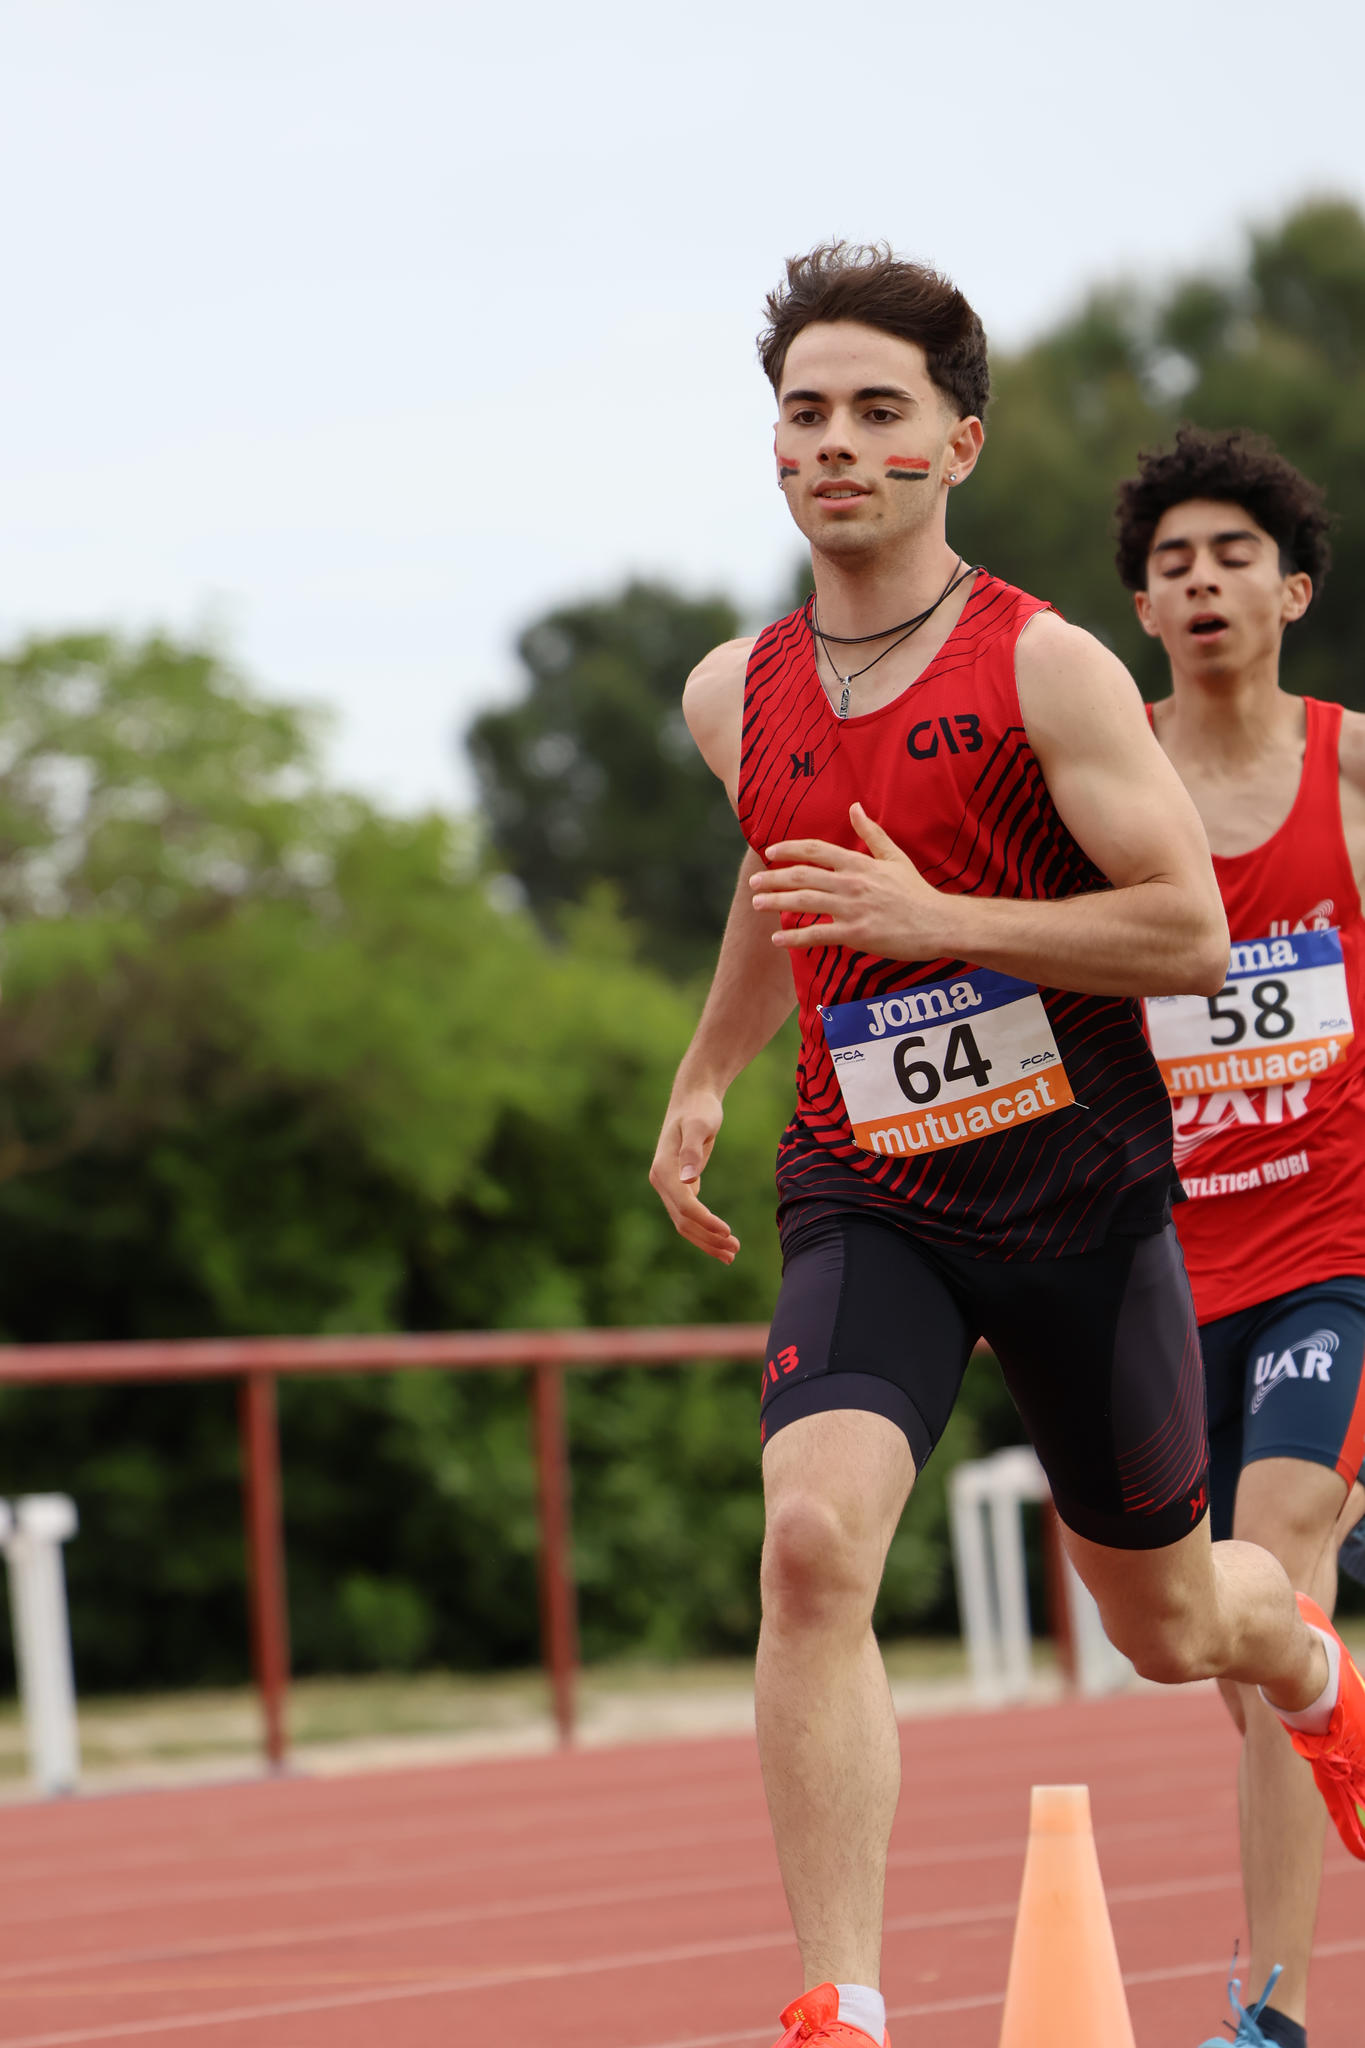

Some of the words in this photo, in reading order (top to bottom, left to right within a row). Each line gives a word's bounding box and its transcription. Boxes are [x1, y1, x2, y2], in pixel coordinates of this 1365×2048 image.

[1229, 939, 1299, 974] ma
[1207, 979, 1295, 1046] 58
[833, 1049, 865, 1063] FCA
[893, 1023, 993, 1104] 64
[1020, 1051, 1055, 1069] FCA
[1171, 1039, 1341, 1091] mutuacat
[869, 1076, 1056, 1155] mutuacat
[1261, 1149, 1310, 1184] RUBÍ
[1254, 1348, 1333, 1386] UAR
